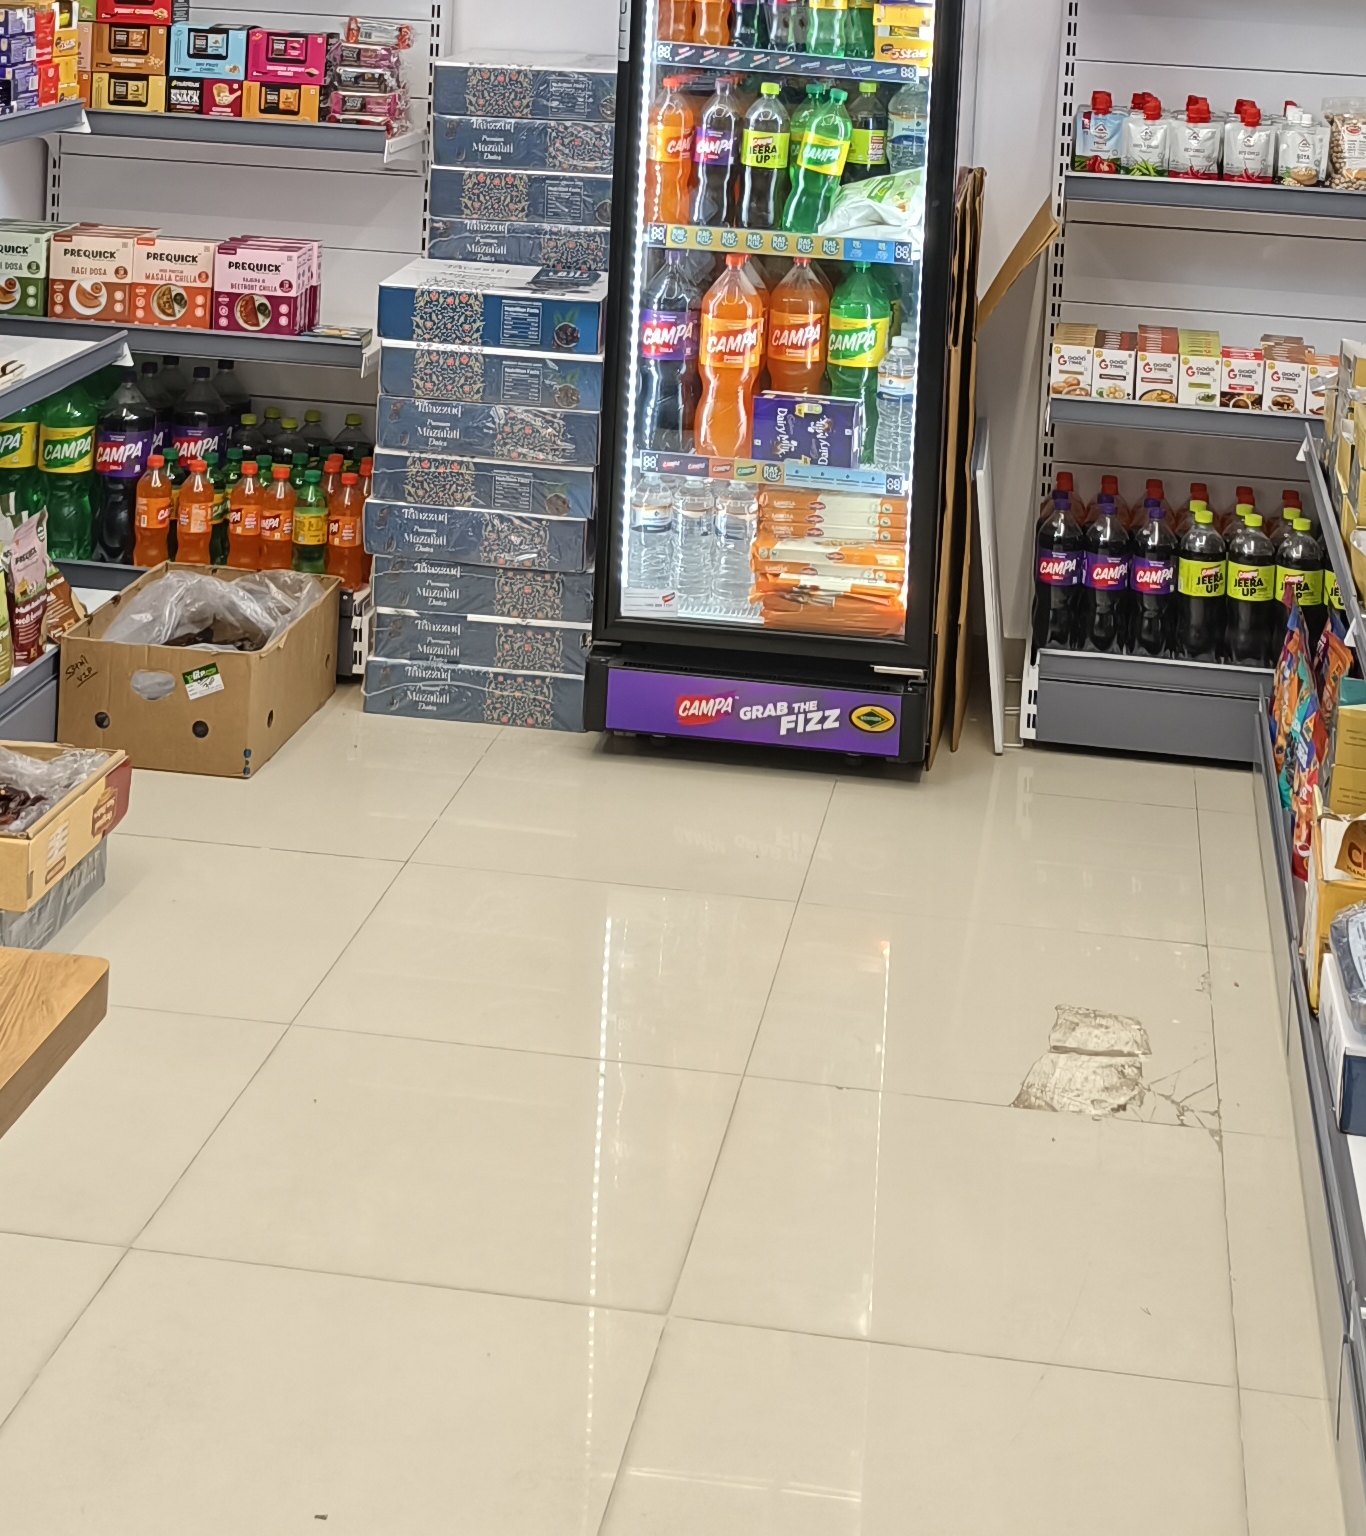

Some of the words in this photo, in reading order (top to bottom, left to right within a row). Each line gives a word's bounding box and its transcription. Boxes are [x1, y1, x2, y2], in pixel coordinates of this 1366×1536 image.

[755, 155, 771, 164] UP
[63, 248, 116, 260] PREQUICK
[146, 251, 198, 264] PREQUICK
[228, 261, 281, 273] PREQUICK
[643, 324, 693, 345] CAMPA
[707, 329, 758, 354] CAMPA
[771, 324, 821, 347] CAMPA
[829, 328, 876, 351] CAMPA
[43, 439, 92, 462] CAMPA
[97, 441, 143, 465] CAMPA
[818, 438, 829, 465] Dairy
[1039, 556, 1077, 575] CAMPA
[1092, 562, 1128, 581] CAMPA
[1136, 566, 1174, 583] CAMPA
[1196, 573, 1224, 585] JEERA
[1234, 578, 1263, 588] JEERA
[1206, 584, 1220, 597] UP
[1242, 586, 1257, 597] UP
[678, 696, 733, 718] CAMPA
[739, 702, 788, 721] GRAB
[792, 700, 818, 713] THE
[779, 709, 840, 736] FIZZ
